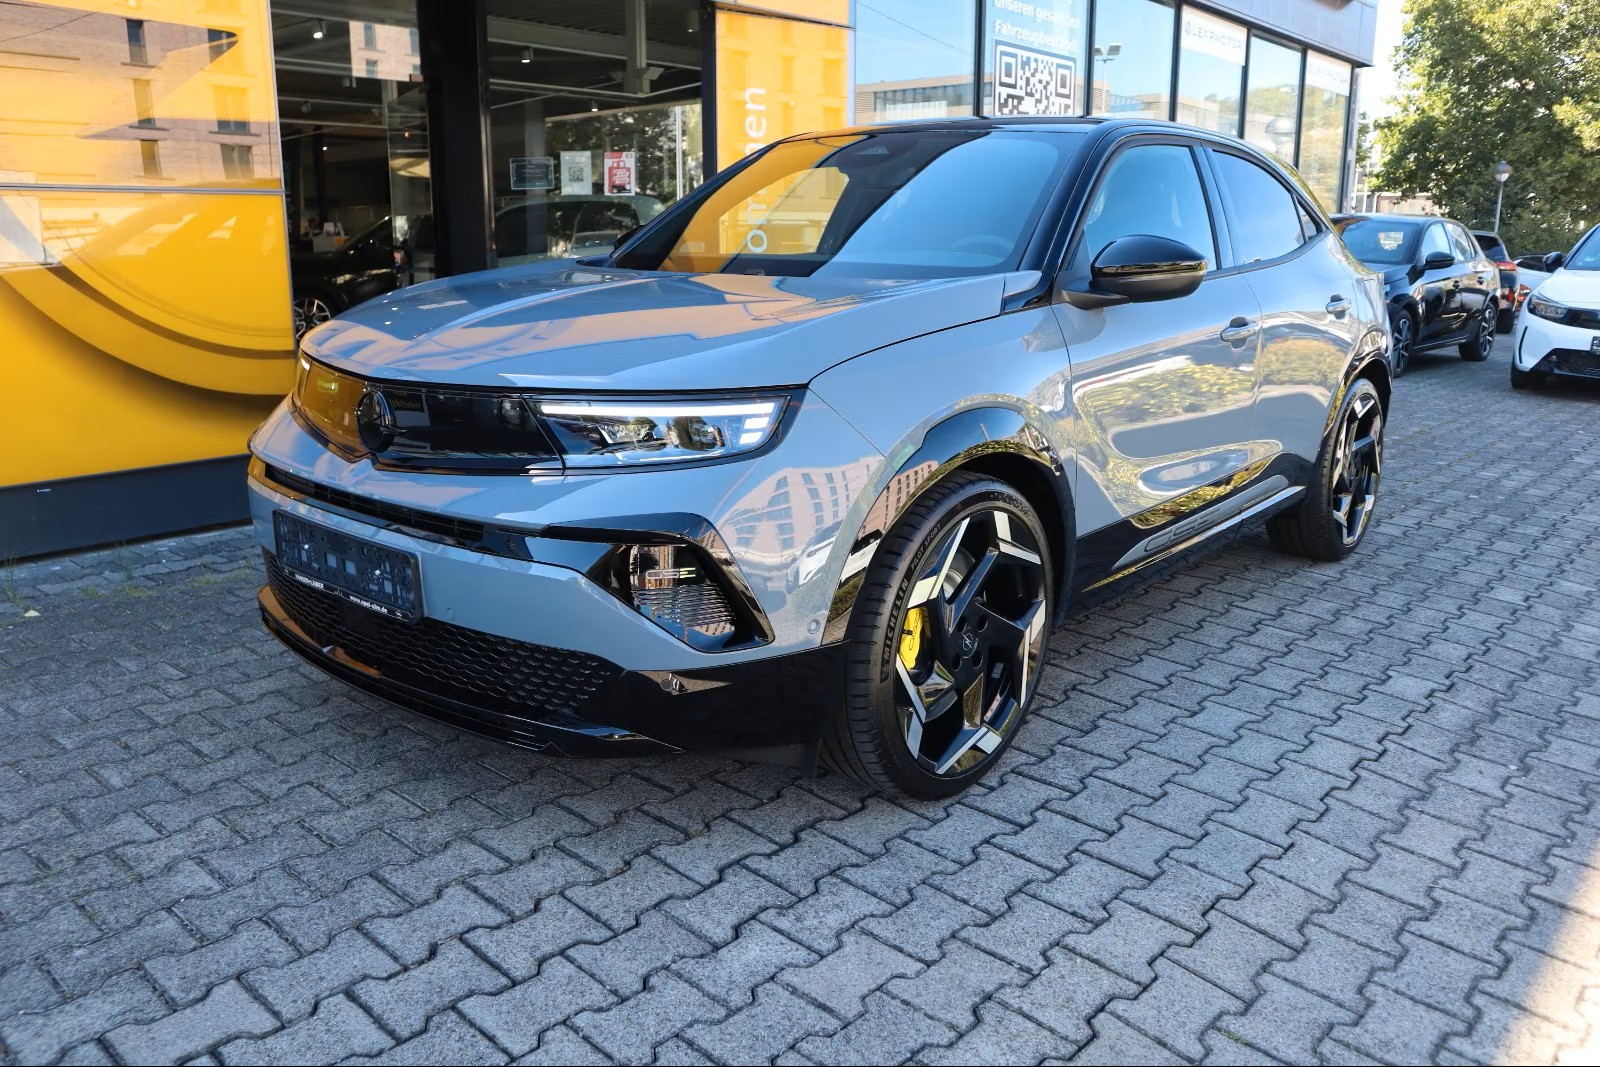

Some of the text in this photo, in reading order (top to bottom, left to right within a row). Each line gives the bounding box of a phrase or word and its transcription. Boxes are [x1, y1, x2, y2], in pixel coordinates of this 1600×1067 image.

[1036, 8, 1080, 28] gesten
[910, 522, 942, 571] PILOT SPORT
[883, 578, 908, 665] MICHELIN
